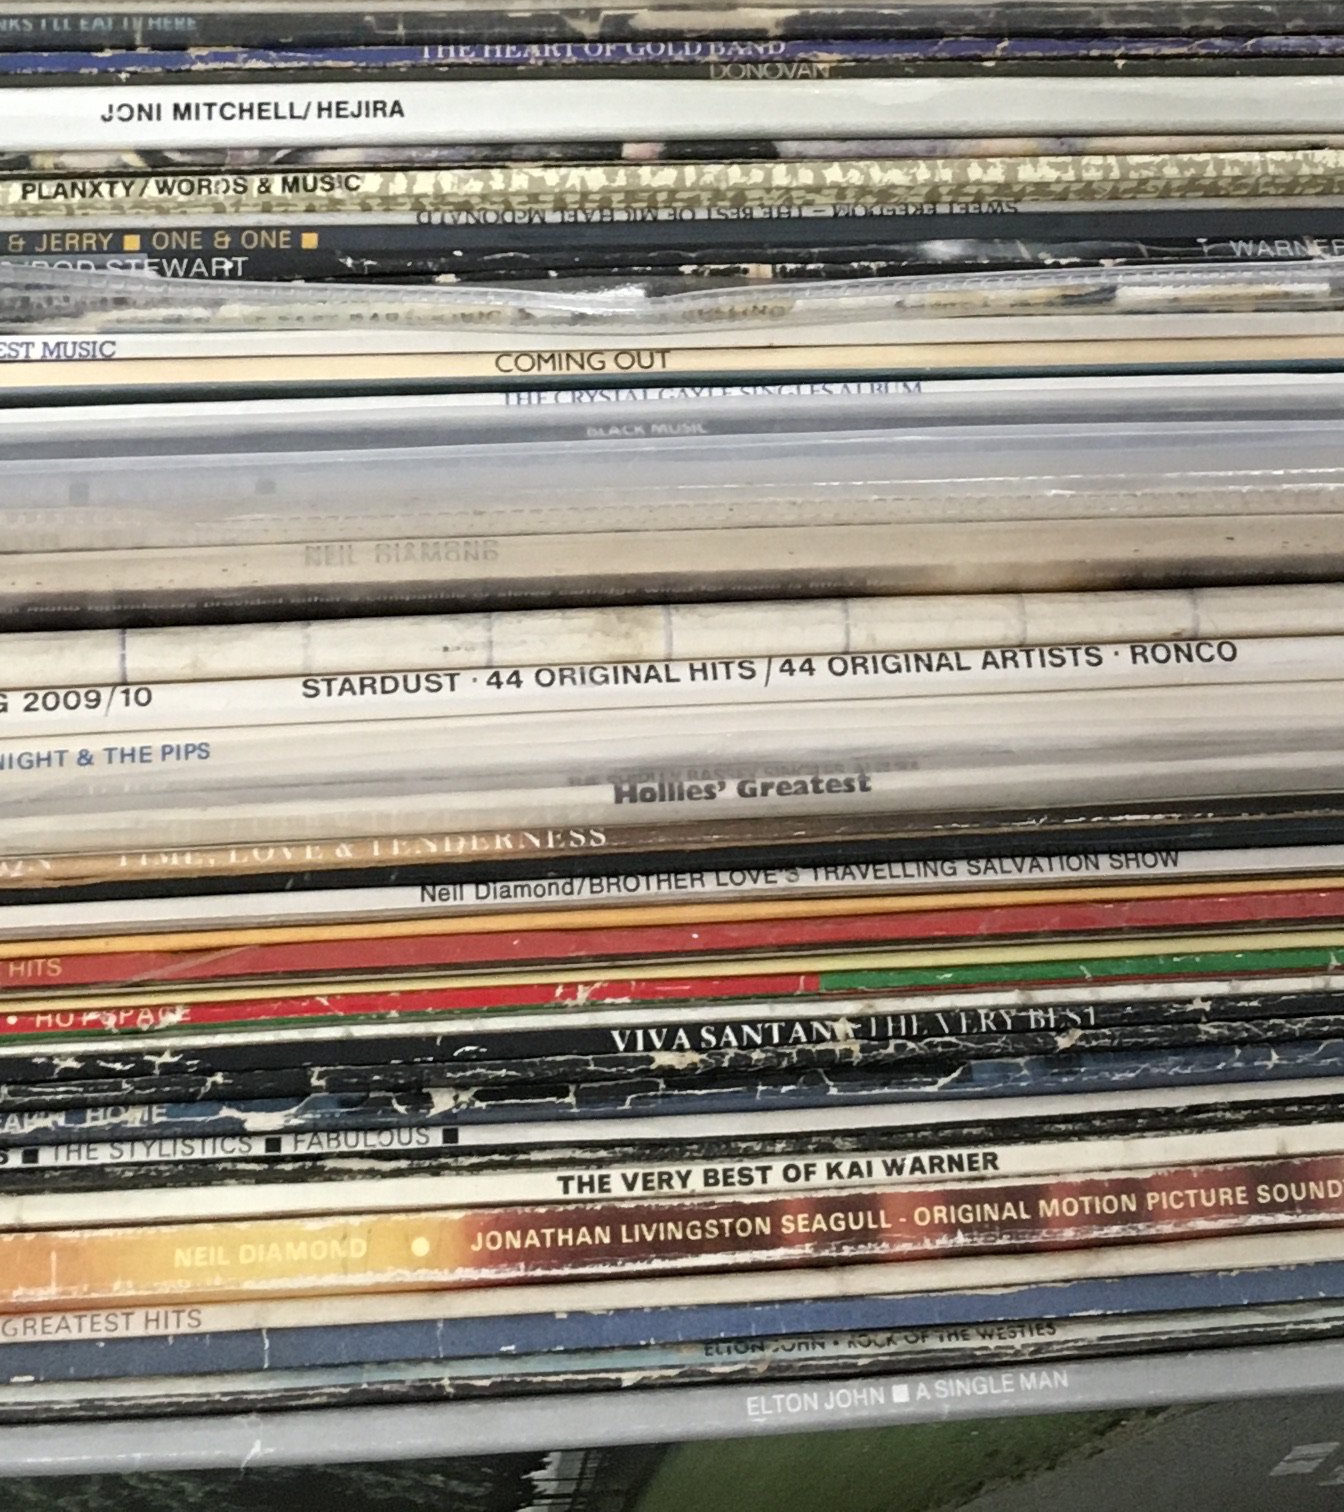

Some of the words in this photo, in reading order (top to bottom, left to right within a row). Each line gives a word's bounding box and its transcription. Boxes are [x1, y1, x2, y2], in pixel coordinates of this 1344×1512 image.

[8, 234, 25, 252] &
[36, 233, 114, 252] JERRY
[151, 232, 203, 250] ONE
[214, 231, 231, 248] &
[240, 230, 292, 248] ONE
[41, 340, 116, 359] MUSIC
[495, 351, 608, 373] COMING
[615, 351, 670, 370] OUT
[302, 673, 460, 699] STARDUST
[487, 670, 523, 689] 44
[534, 662, 680, 687] ORIGINAL
[831, 651, 970, 677] ORIGINAL
[983, 646, 1104, 669] ARTISTS
[1130, 641, 1238, 666] RONCO
[77, 749, 95, 766] &
[103, 745, 154, 766] THE
[161, 743, 210, 762] PIPS
[737, 774, 872, 799] Greatest
[557, 1174, 612, 1196] THE
[621, 1169, 693, 1192] VERY
[702, 1165, 772, 1188] BEST
[782, 1162, 816, 1183] OF
[825, 1159, 874, 1181] KAI
[884, 1151, 999, 1176] WARNER
[470, 1224, 611, 1252] JONATHAN
[621, 1218, 771, 1244] LIVINGSTON
[781, 1210, 891, 1234] SEAGULL
[913, 1200, 1031, 1227] ORIGINAL
[1038, 1193, 1137, 1218] MOTION
[1146, 1186, 1249, 1211] PICTURE
[1, 1312, 135, 1337] GREATEST
[144, 1309, 202, 1330] HITS
[747, 1392, 817, 1417] ELTON
[824, 1387, 885, 1410] JOHN
[916, 1382, 931, 1399] A
[935, 1376, 1019, 1398] SINGLE
[1023, 1371, 1068, 1391] MAN
